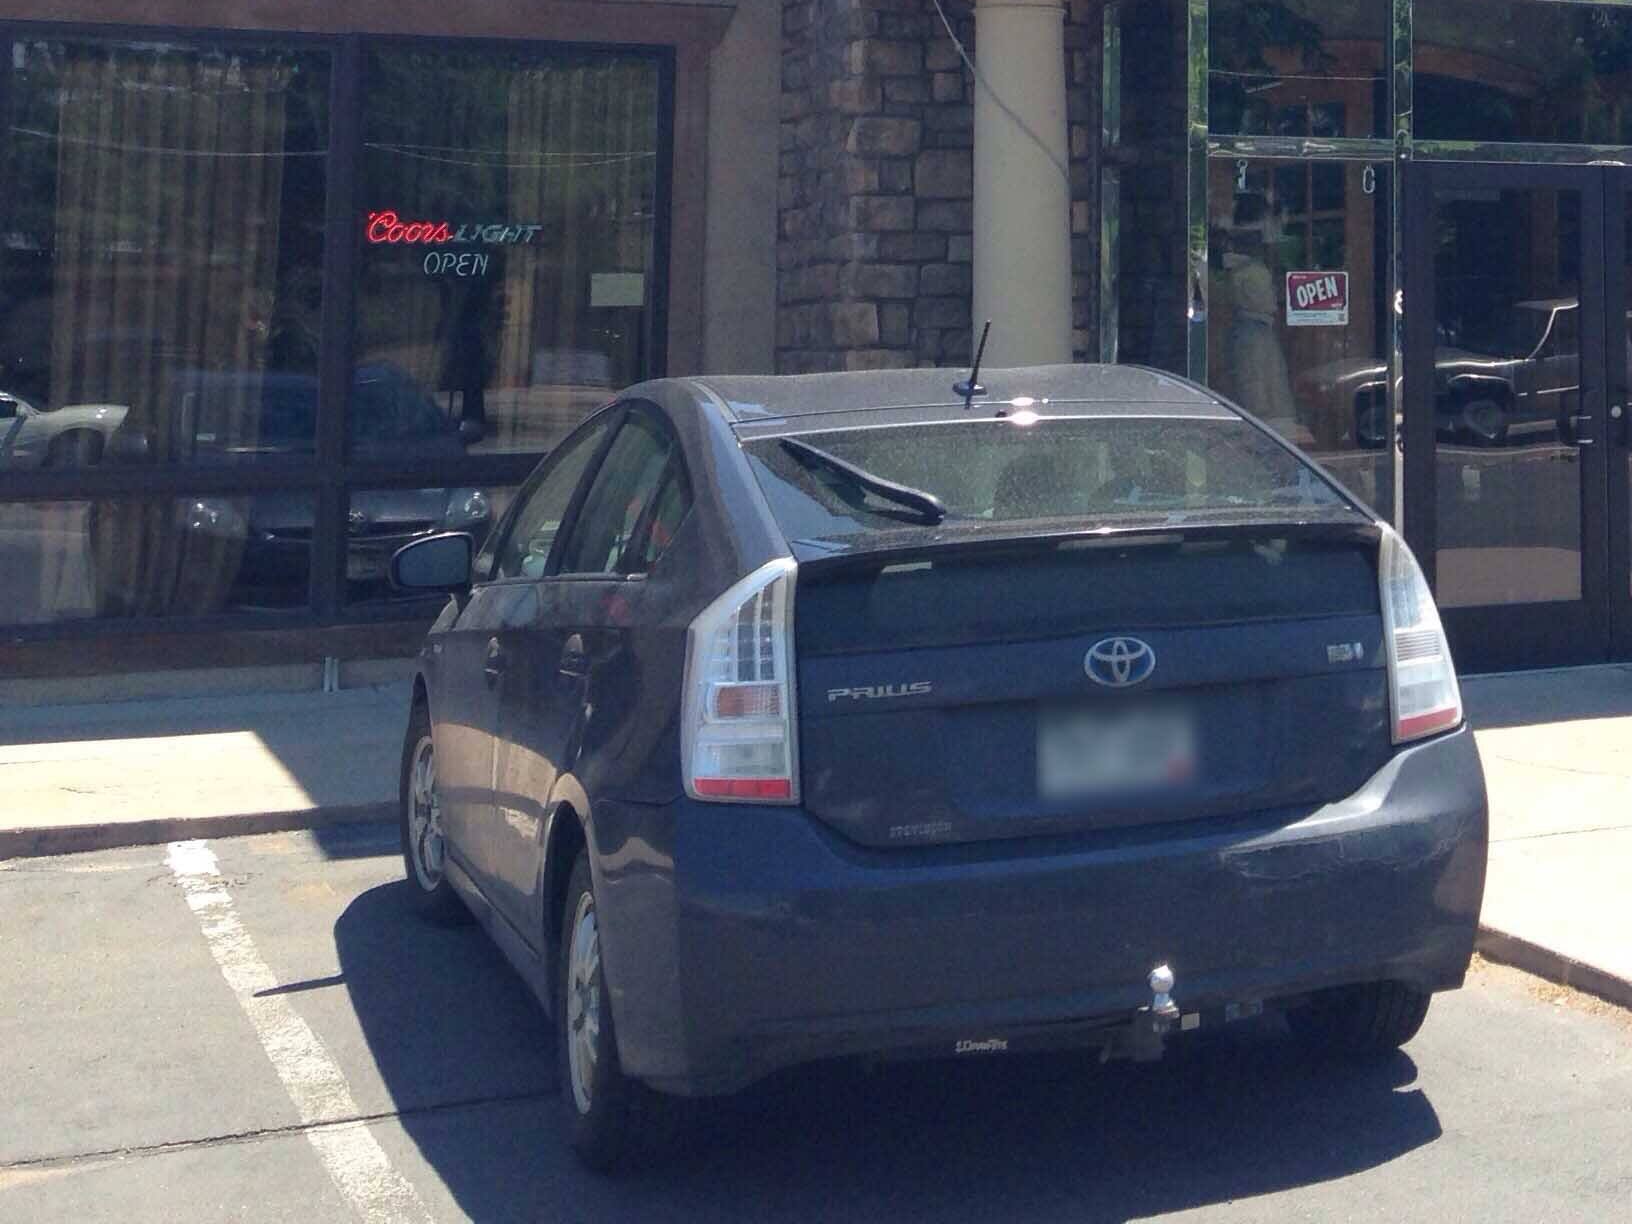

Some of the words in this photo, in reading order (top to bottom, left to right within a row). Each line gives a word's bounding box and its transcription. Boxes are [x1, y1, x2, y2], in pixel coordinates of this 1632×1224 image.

[366, 211, 452, 245] Coors
[452, 225, 543, 243] LIGHT
[423, 251, 490, 277] OPEN
[1296, 275, 1338, 308] OPEN
[827, 681, 932, 702] PRIUS
